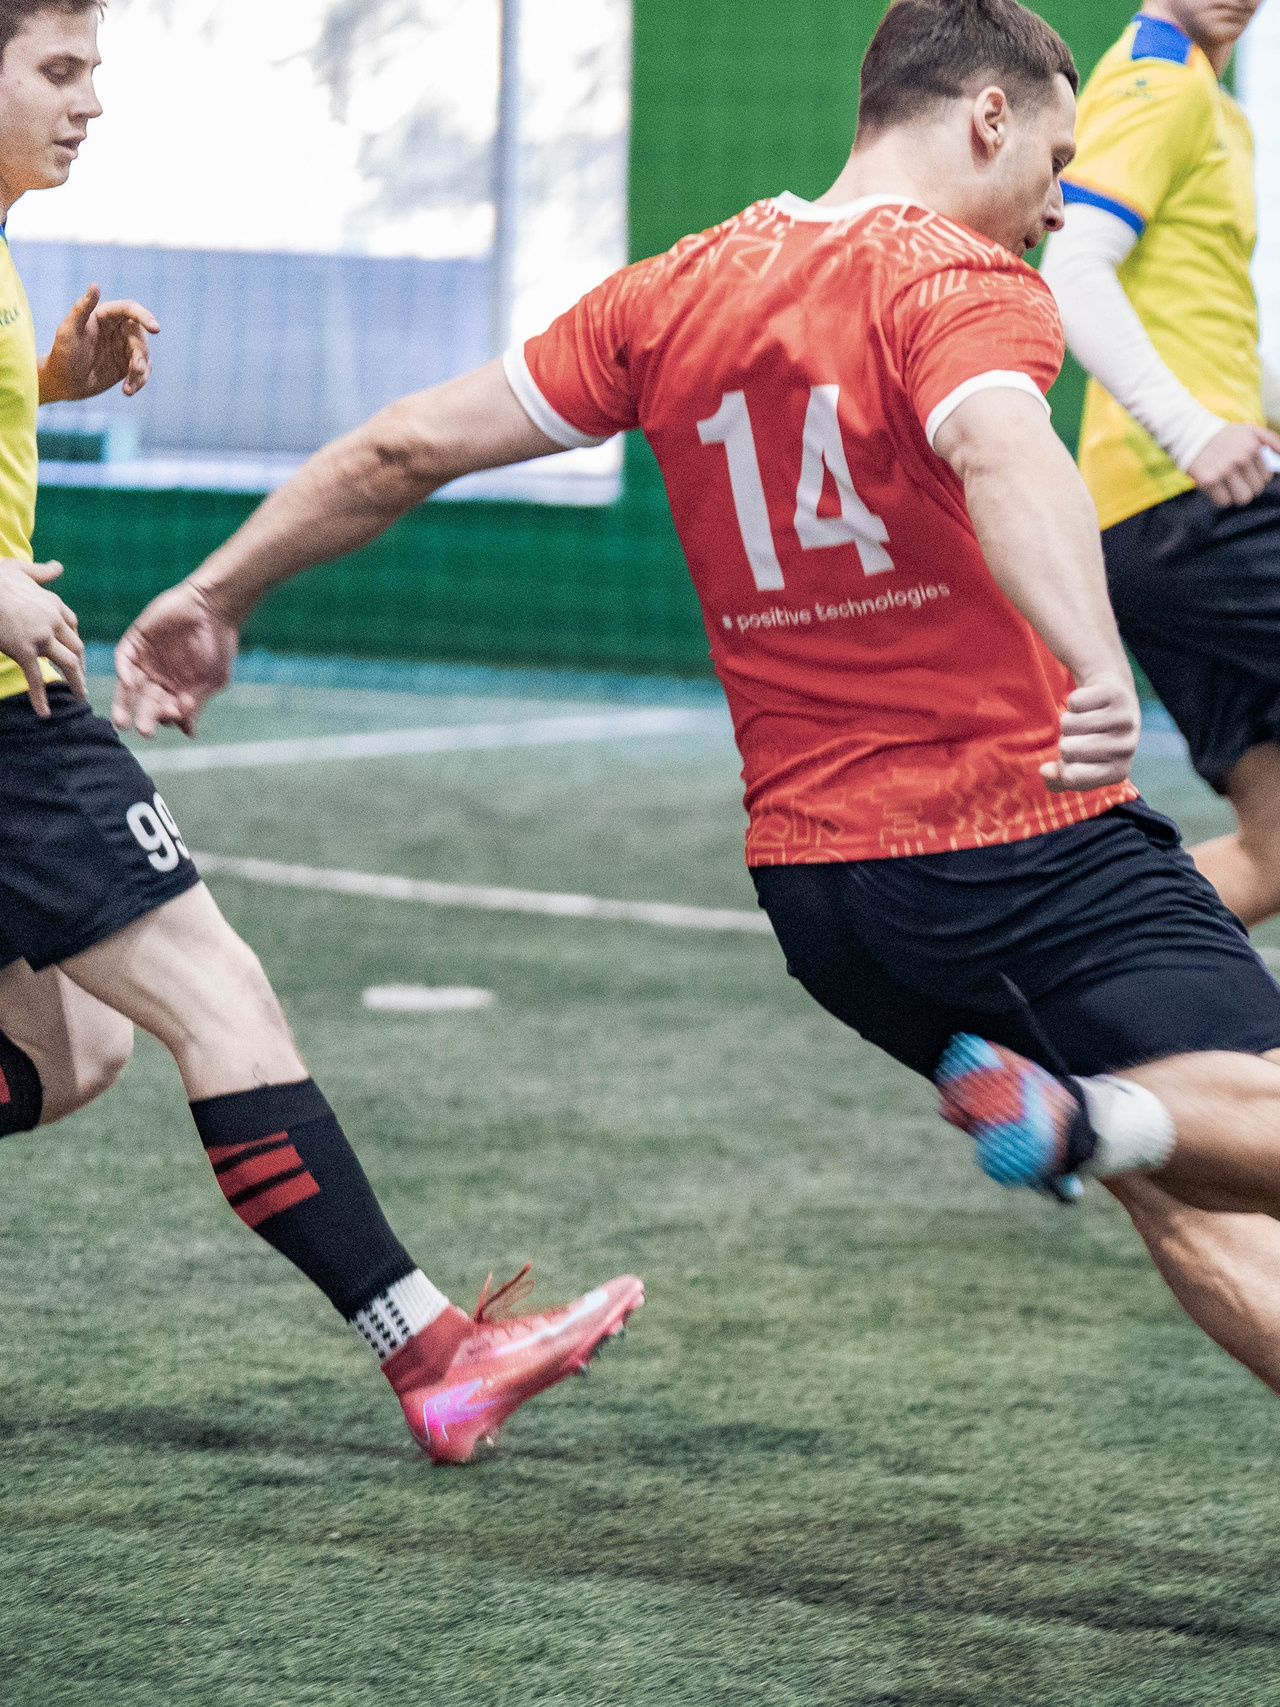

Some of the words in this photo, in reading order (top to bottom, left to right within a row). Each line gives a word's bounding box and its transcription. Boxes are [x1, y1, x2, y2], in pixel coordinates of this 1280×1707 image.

[697, 384, 895, 591] 14
[736, 608, 811, 634] positive
[815, 583, 950, 621] technologies
